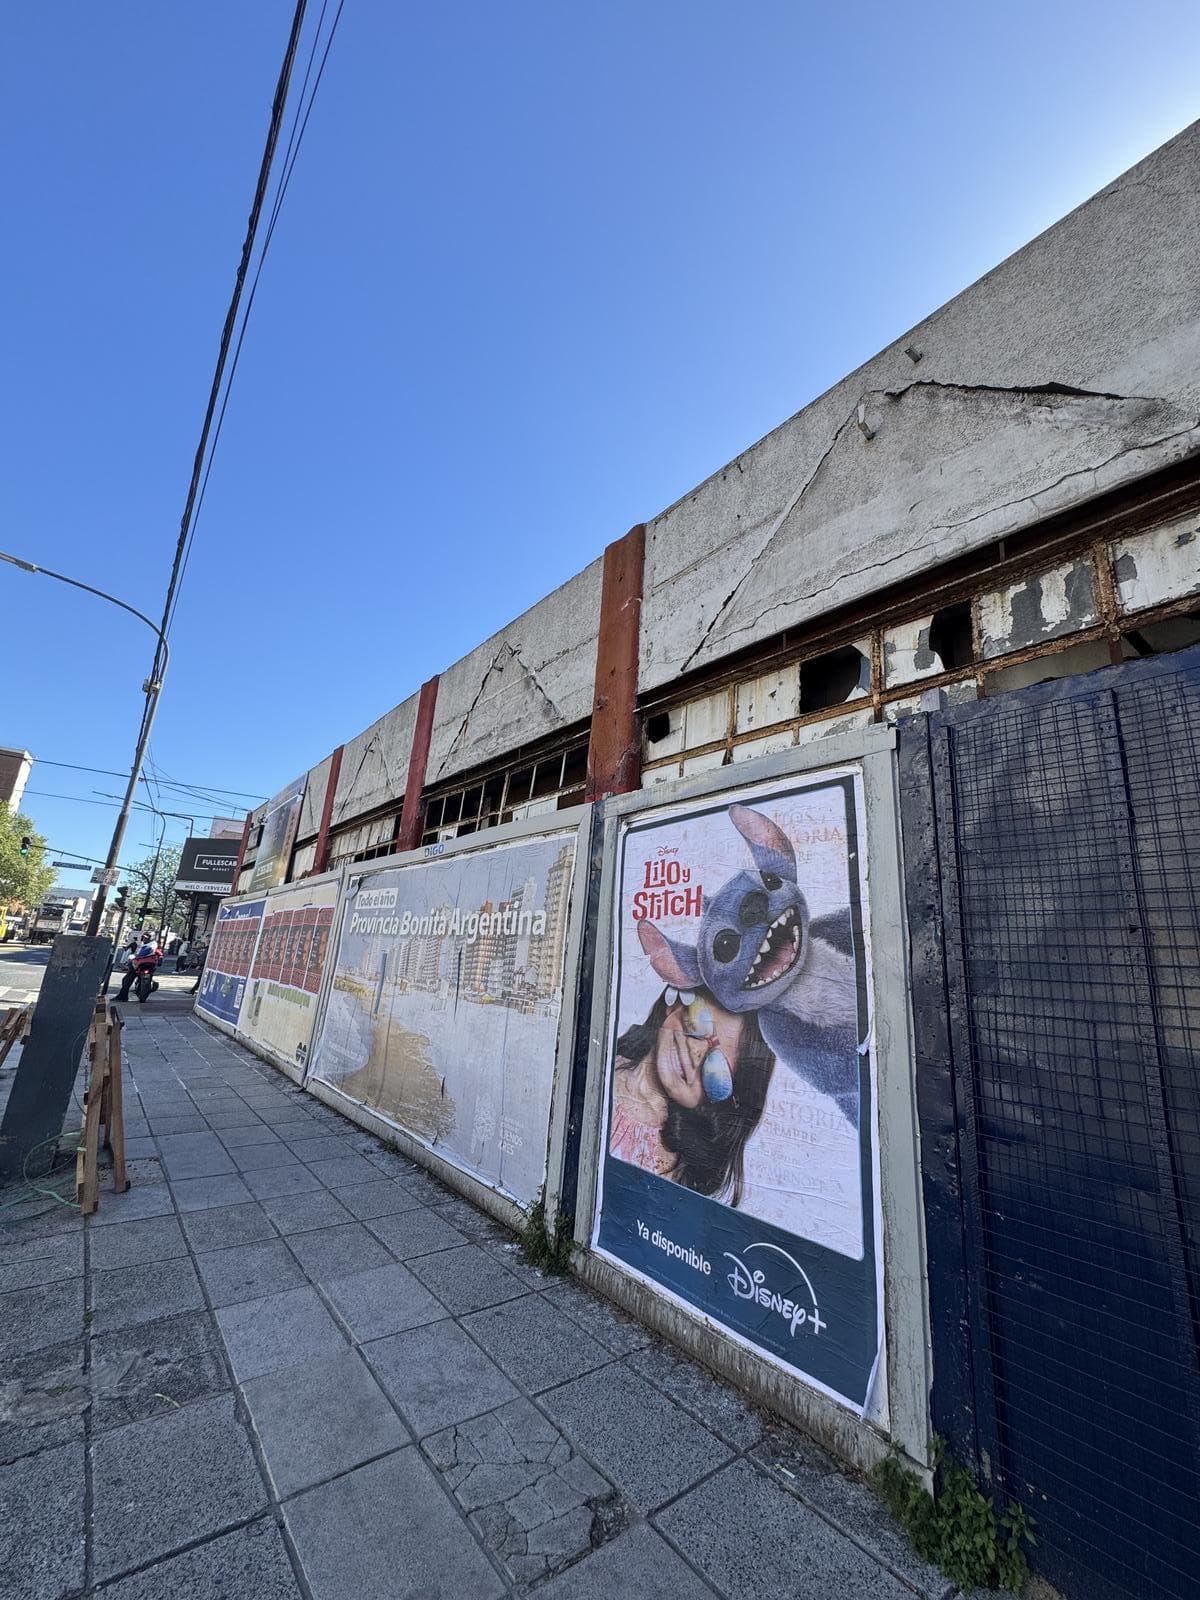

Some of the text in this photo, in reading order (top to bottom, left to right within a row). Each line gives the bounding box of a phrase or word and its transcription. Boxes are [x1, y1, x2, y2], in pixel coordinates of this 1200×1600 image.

[202, 859, 238, 867] FULLESCAB
[657, 846, 679, 856] Disney
[350, 909, 399, 935] Provincia
[400, 908, 446, 936] Bonita
[447, 901, 547, 944] Argentina
[636, 1219, 711, 1275] Ya disponible
